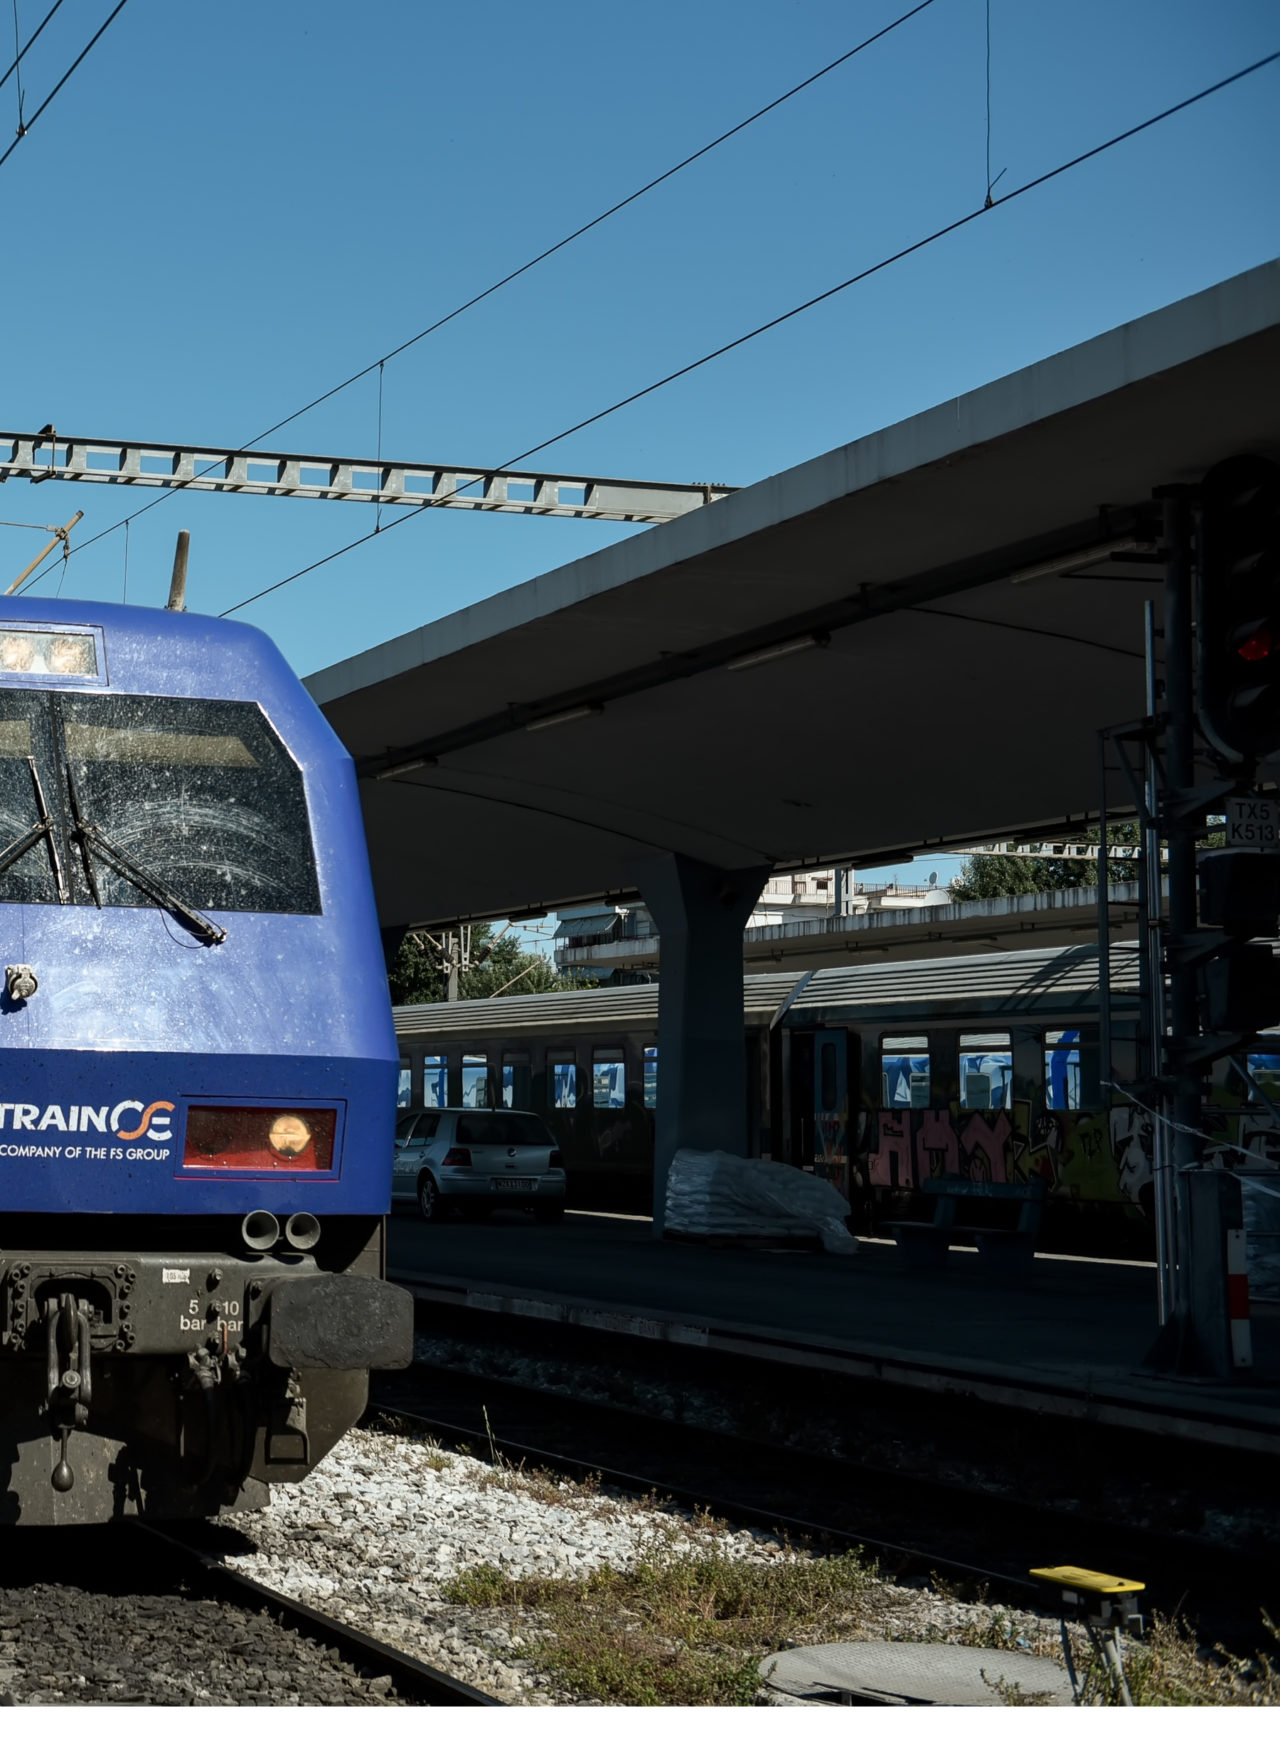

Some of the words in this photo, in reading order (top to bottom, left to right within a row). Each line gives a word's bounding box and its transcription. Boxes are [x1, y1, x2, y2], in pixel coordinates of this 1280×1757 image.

[1235, 802, 1270, 820] TX5
[1231, 823, 1275, 842] K513
[64, 1146, 82, 1159] OF
[85, 1147, 107, 1159] THE
[110, 1147, 124, 1160] FS
[126, 1148, 170, 1161] GROUP
[188, 1299, 199, 1315] 5
[222, 1301, 240, 1316] 10
[180, 1314, 207, 1331] bar
[216, 1316, 244, 1332] bar
